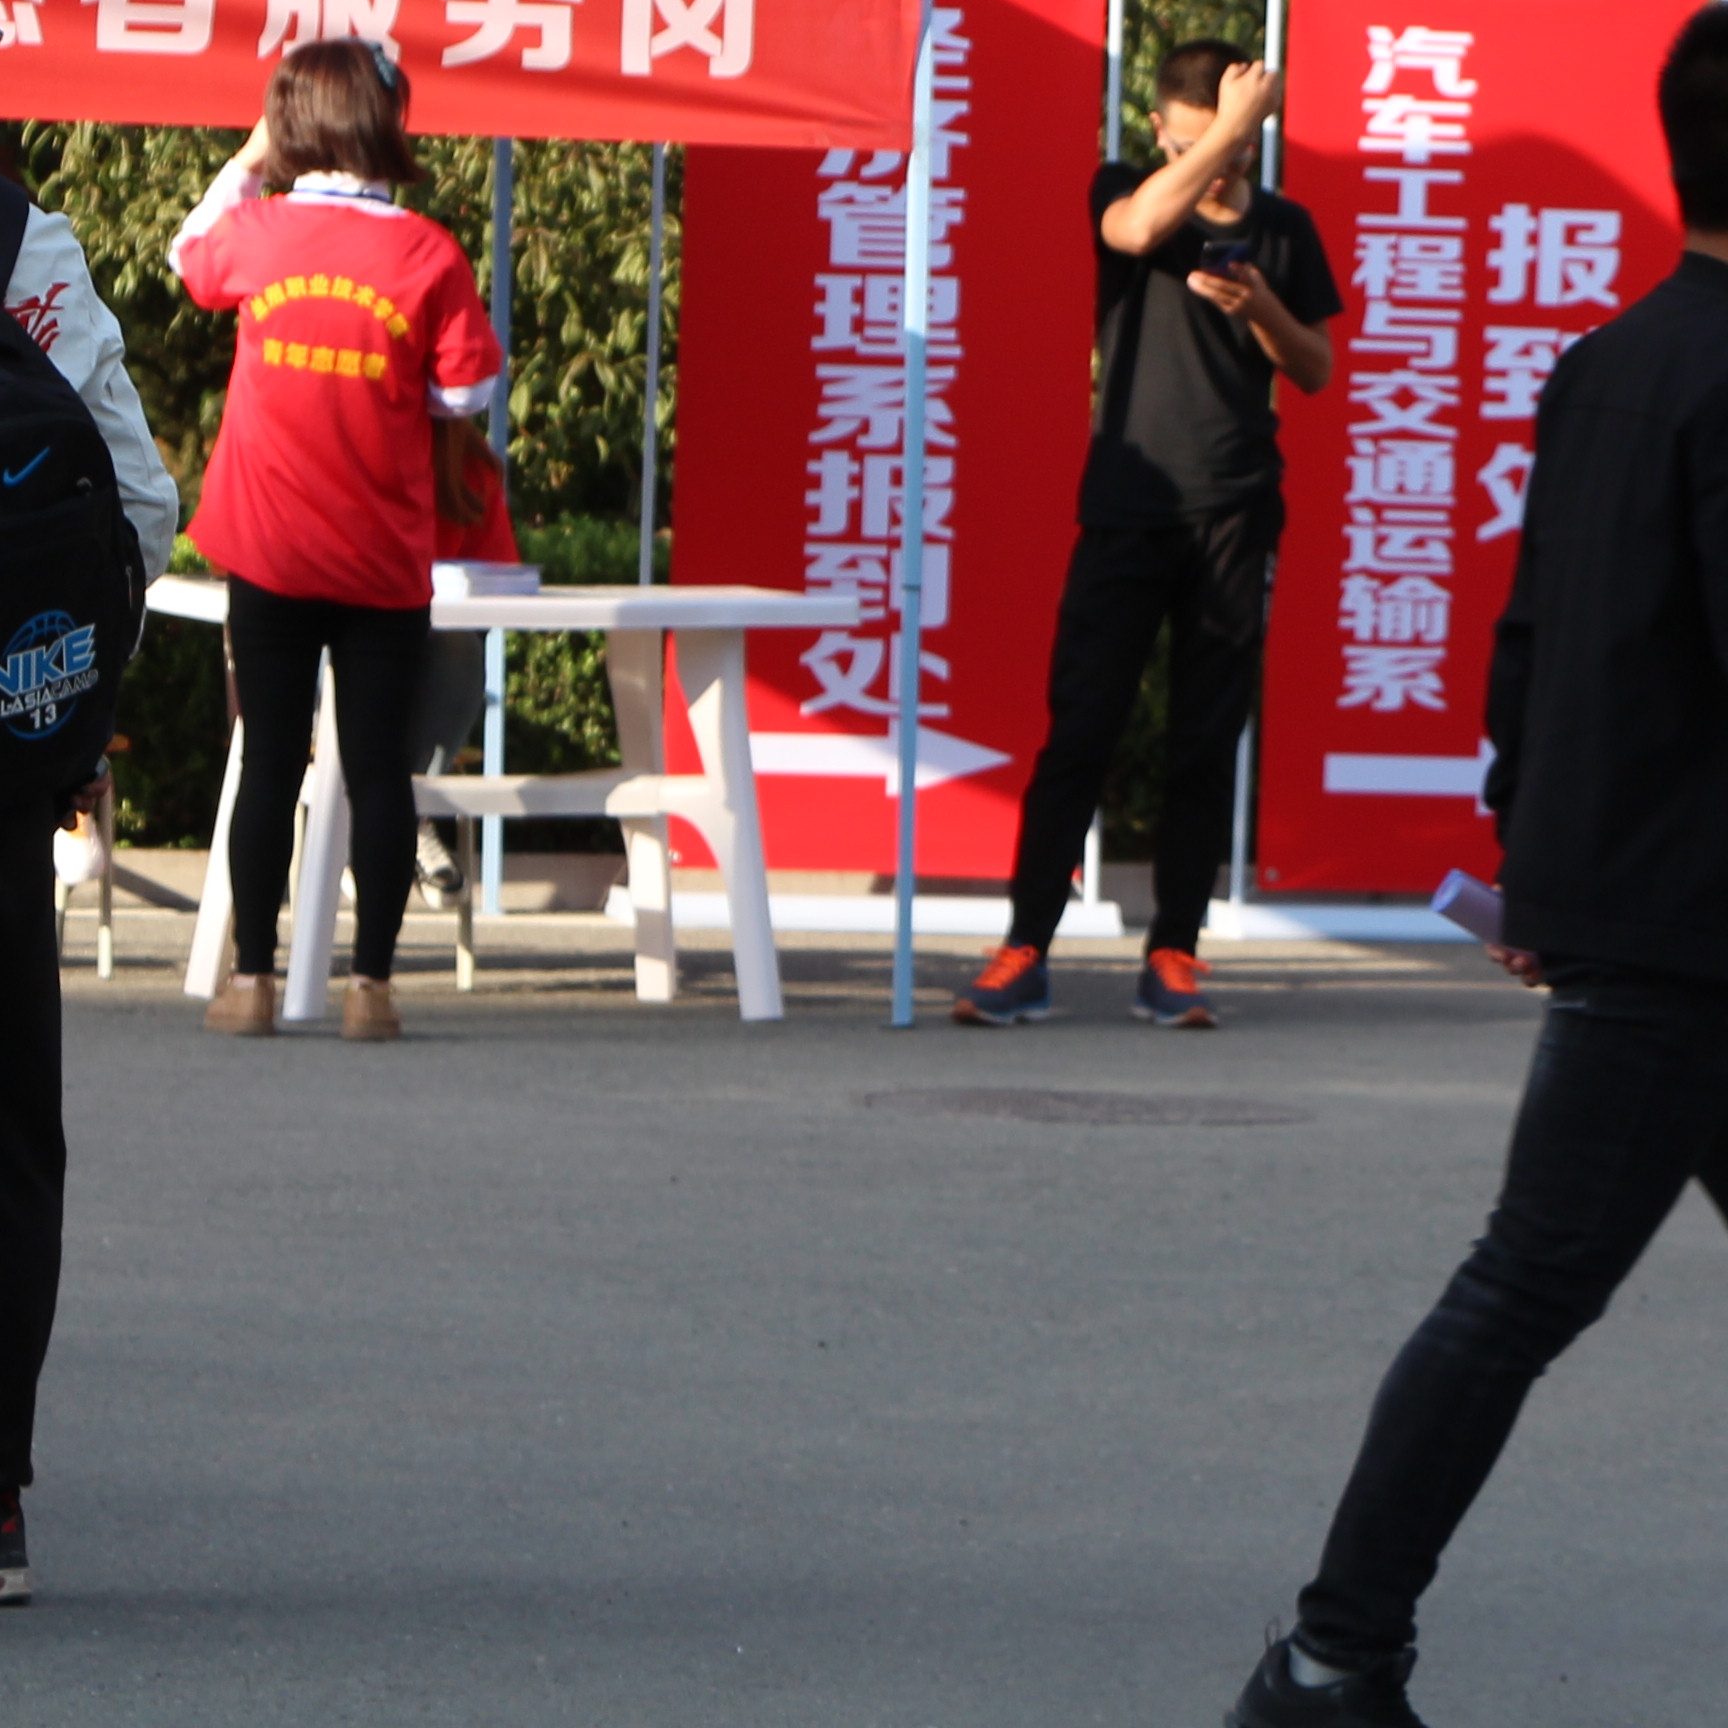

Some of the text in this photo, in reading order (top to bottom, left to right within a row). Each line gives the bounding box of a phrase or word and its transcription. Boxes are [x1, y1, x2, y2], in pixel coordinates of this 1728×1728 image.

[1334, 25, 1478, 712] 汽车工程与交通运输系
[29, 702, 58, 730] 13
